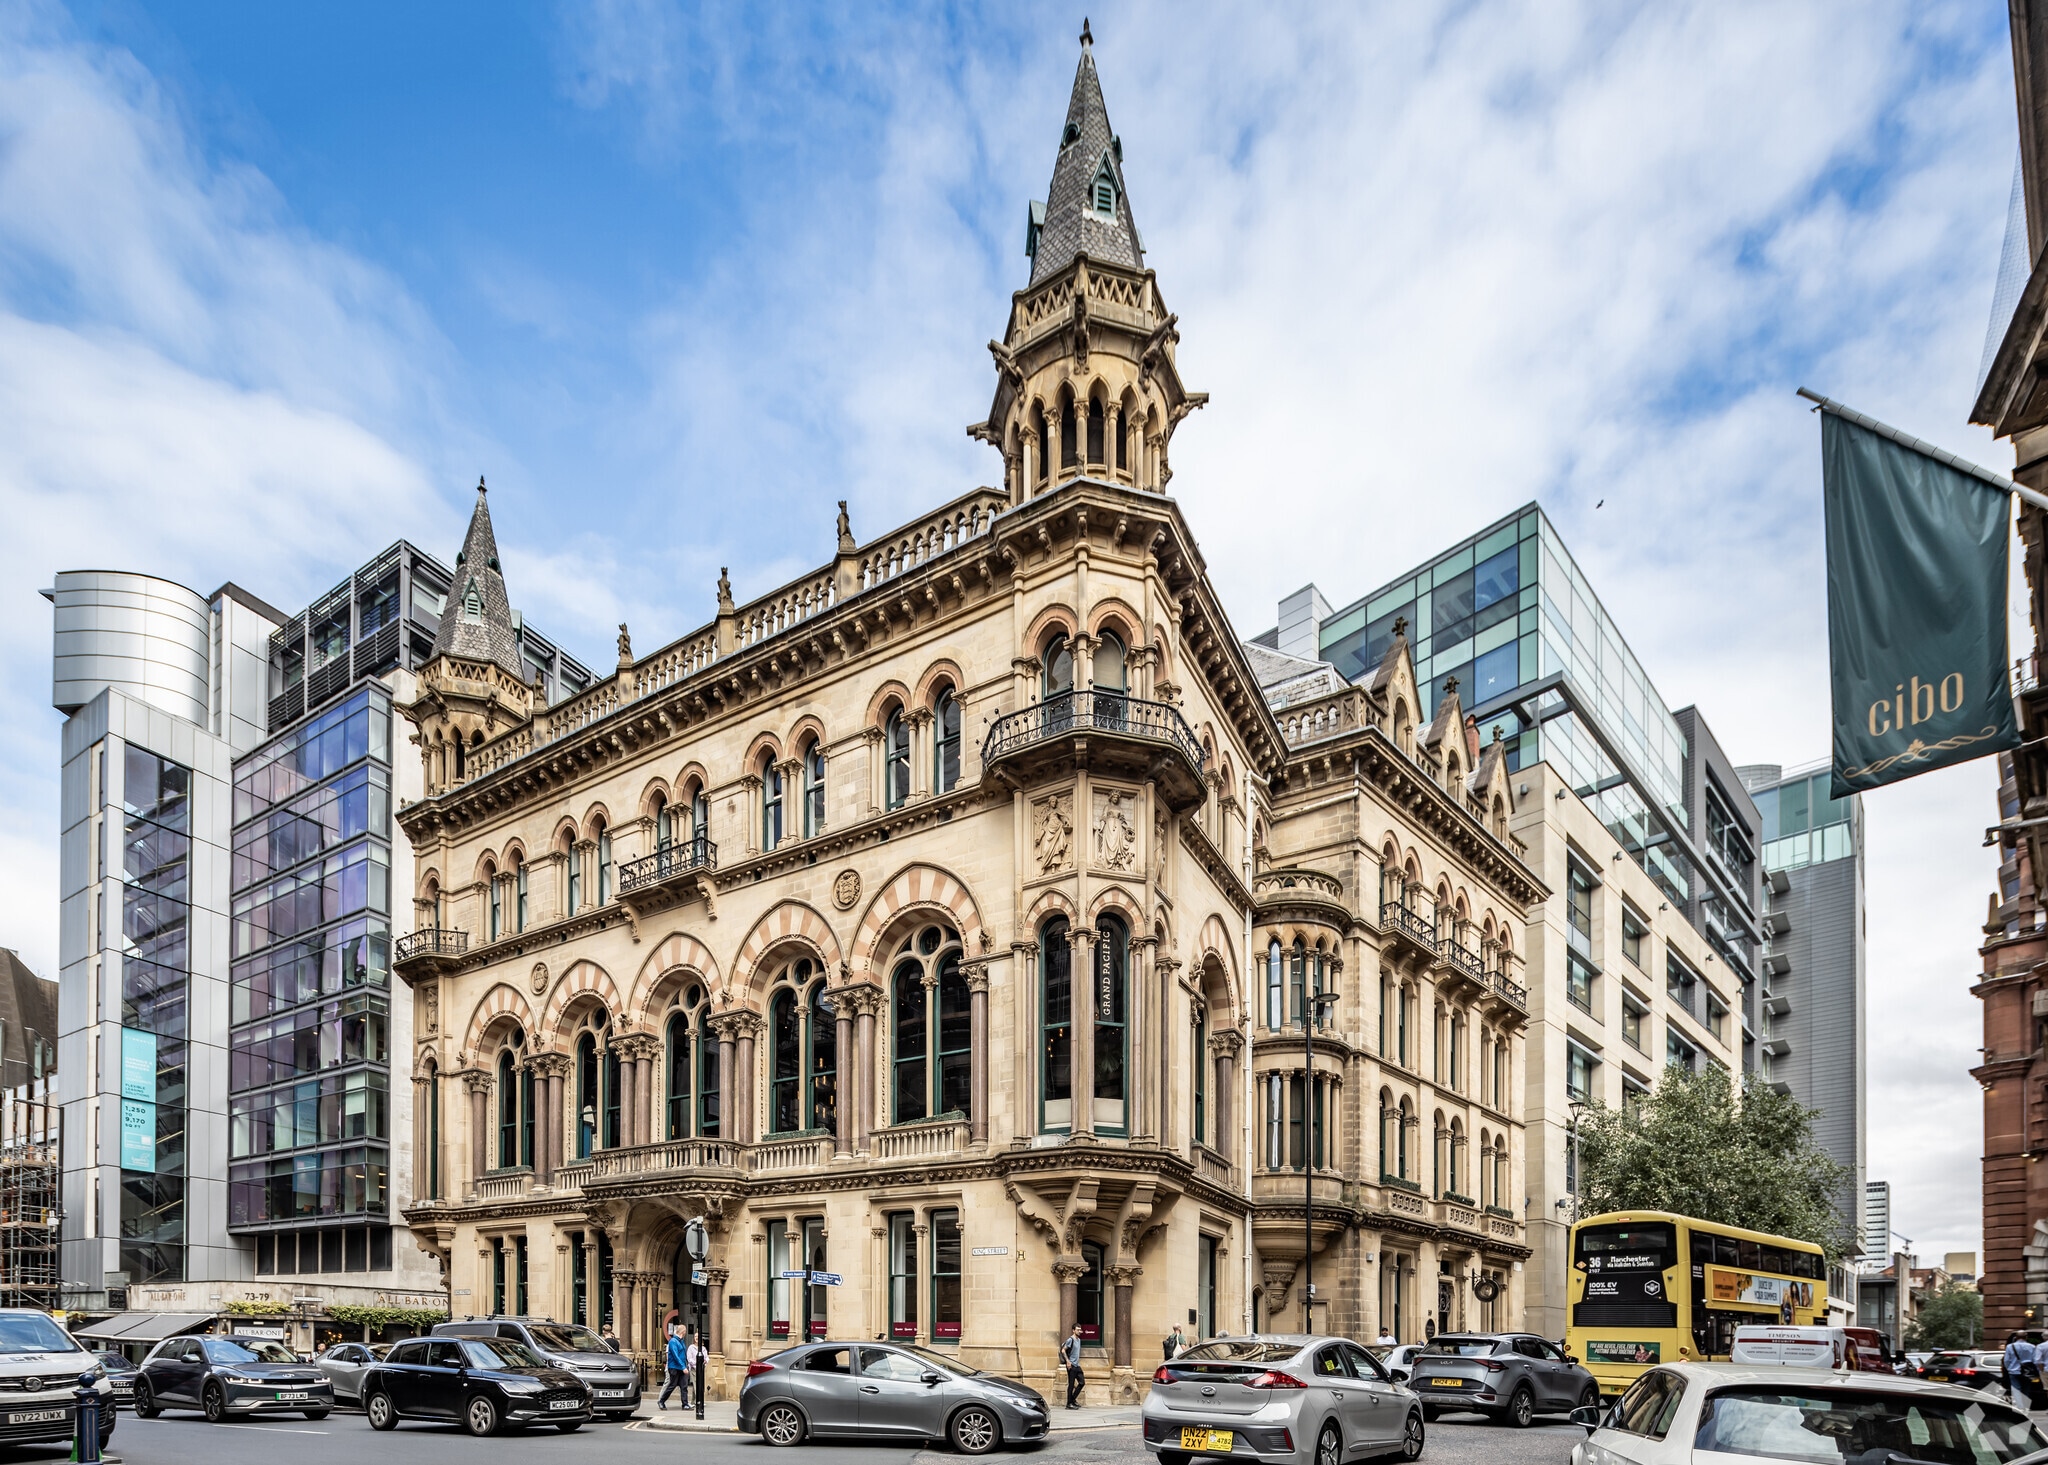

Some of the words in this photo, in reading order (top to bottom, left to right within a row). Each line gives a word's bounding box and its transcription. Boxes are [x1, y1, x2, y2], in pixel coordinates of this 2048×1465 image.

[1868, 672, 1964, 737] cibo
[1103, 931, 1111, 975] PACIFIC
[1103, 977, 1111, 1016] GRAND
[125, 1105, 146, 1114] 1,250
[125, 1116, 146, 1125] 9,170
[1589, 1257, 1601, 1268] 36
[1758, 1280, 1768, 1290] JUICE
[244, 1292, 270, 1301] 73-79
[405, 1296, 429, 1305] BAR
[1764, 1291, 1778, 1301] SUMMER
[14, 1413, 40, 1422] DY22
[43, 1412, 62, 1420] UWX
[1183, 1428, 1206, 1438] DN22
[1185, 1438, 1202, 1448] ZXY
